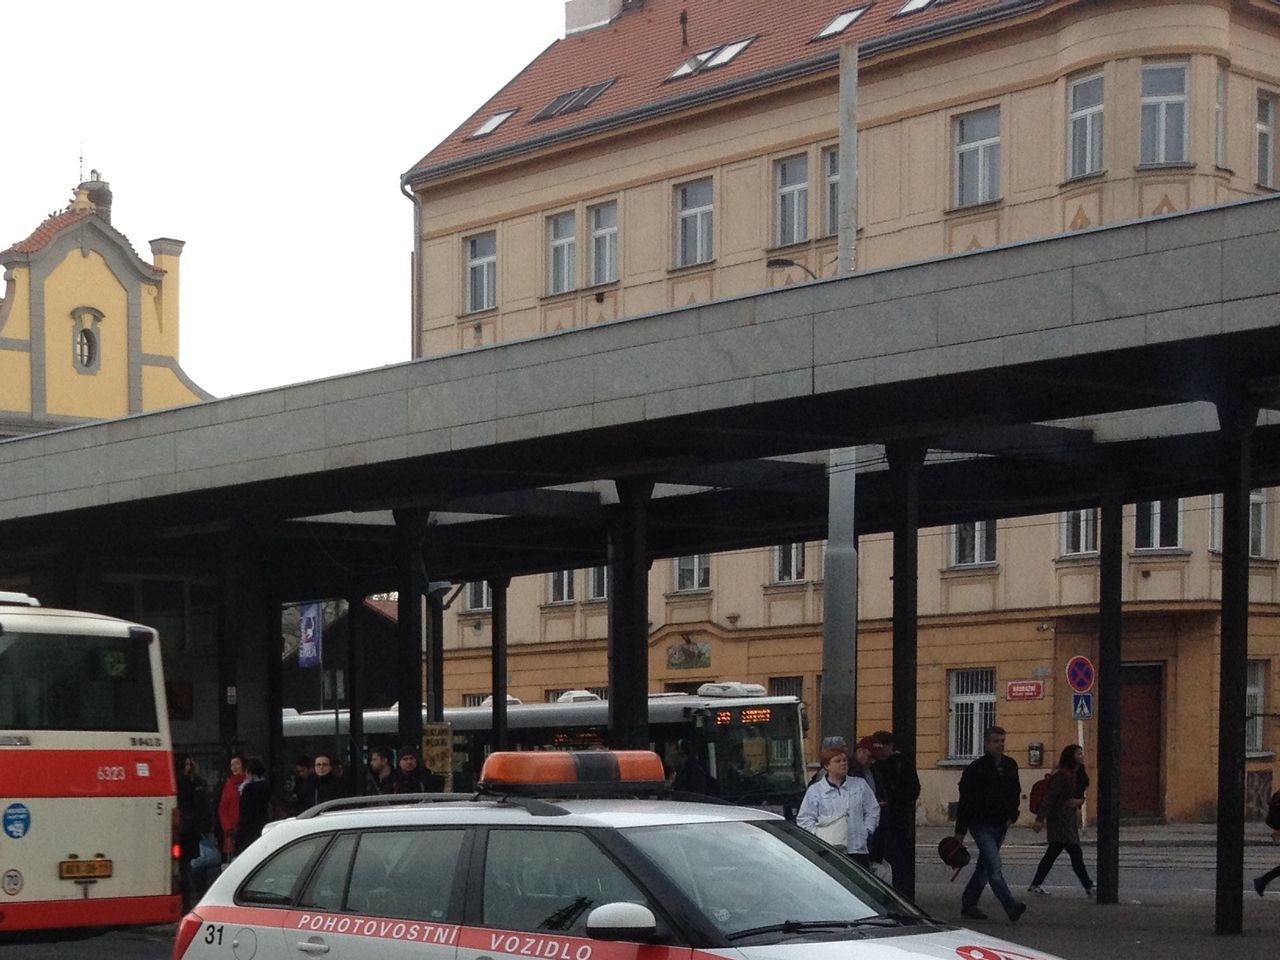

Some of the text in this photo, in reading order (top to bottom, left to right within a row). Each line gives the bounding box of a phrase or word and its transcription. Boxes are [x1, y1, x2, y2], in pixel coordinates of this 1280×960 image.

[96, 766, 126, 781] 6323
[204, 924, 225, 946] 31
[297, 914, 459, 945] POHOTOVOSTNÍ
